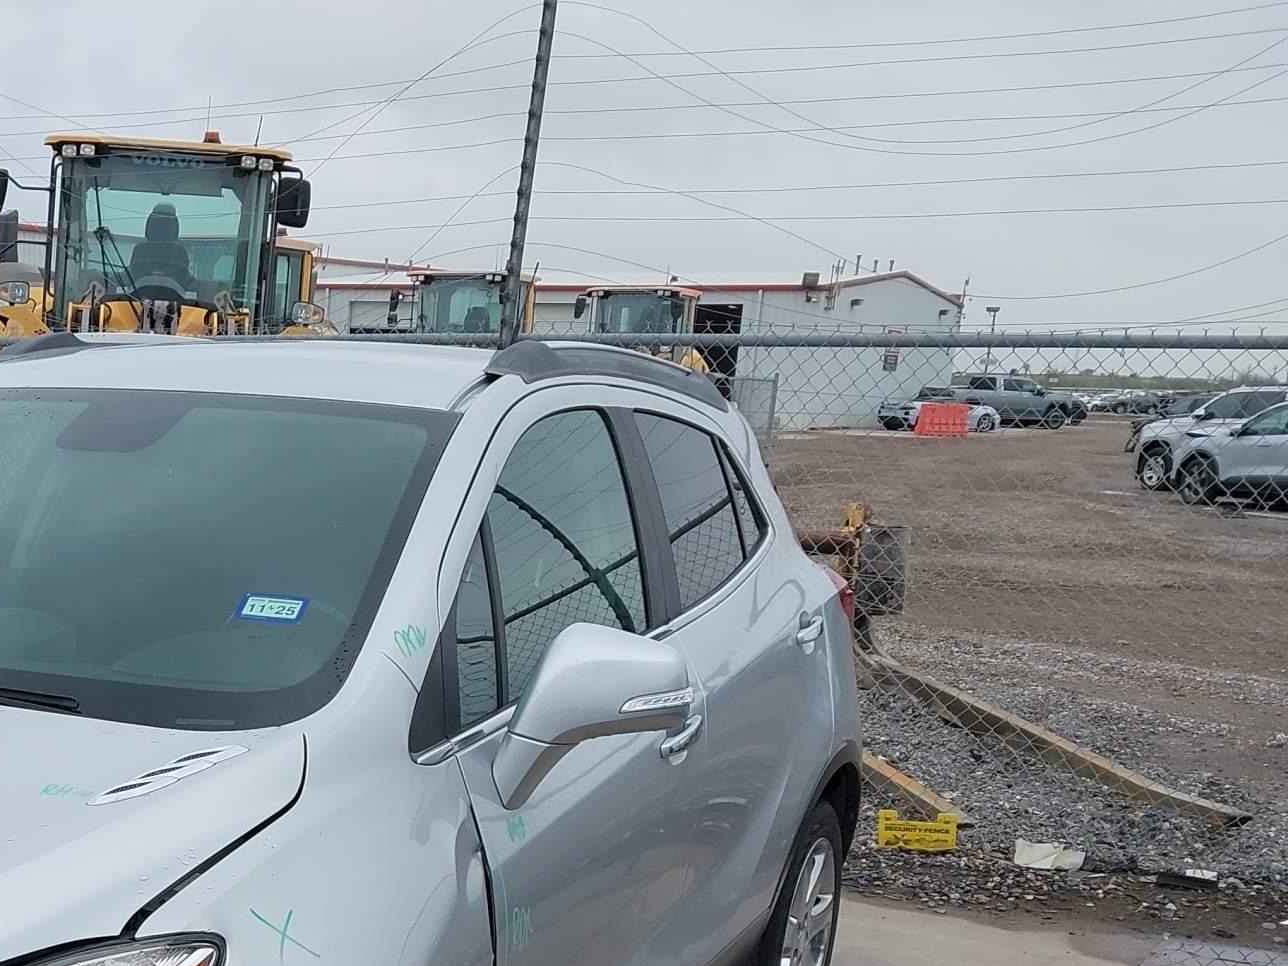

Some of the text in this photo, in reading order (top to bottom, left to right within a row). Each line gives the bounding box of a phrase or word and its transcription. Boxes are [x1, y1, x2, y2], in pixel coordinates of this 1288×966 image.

[133, 154, 205, 168] VOLVO
[884, 825, 923, 833] SECURITY
[923, 827, 950, 835] FENCE
